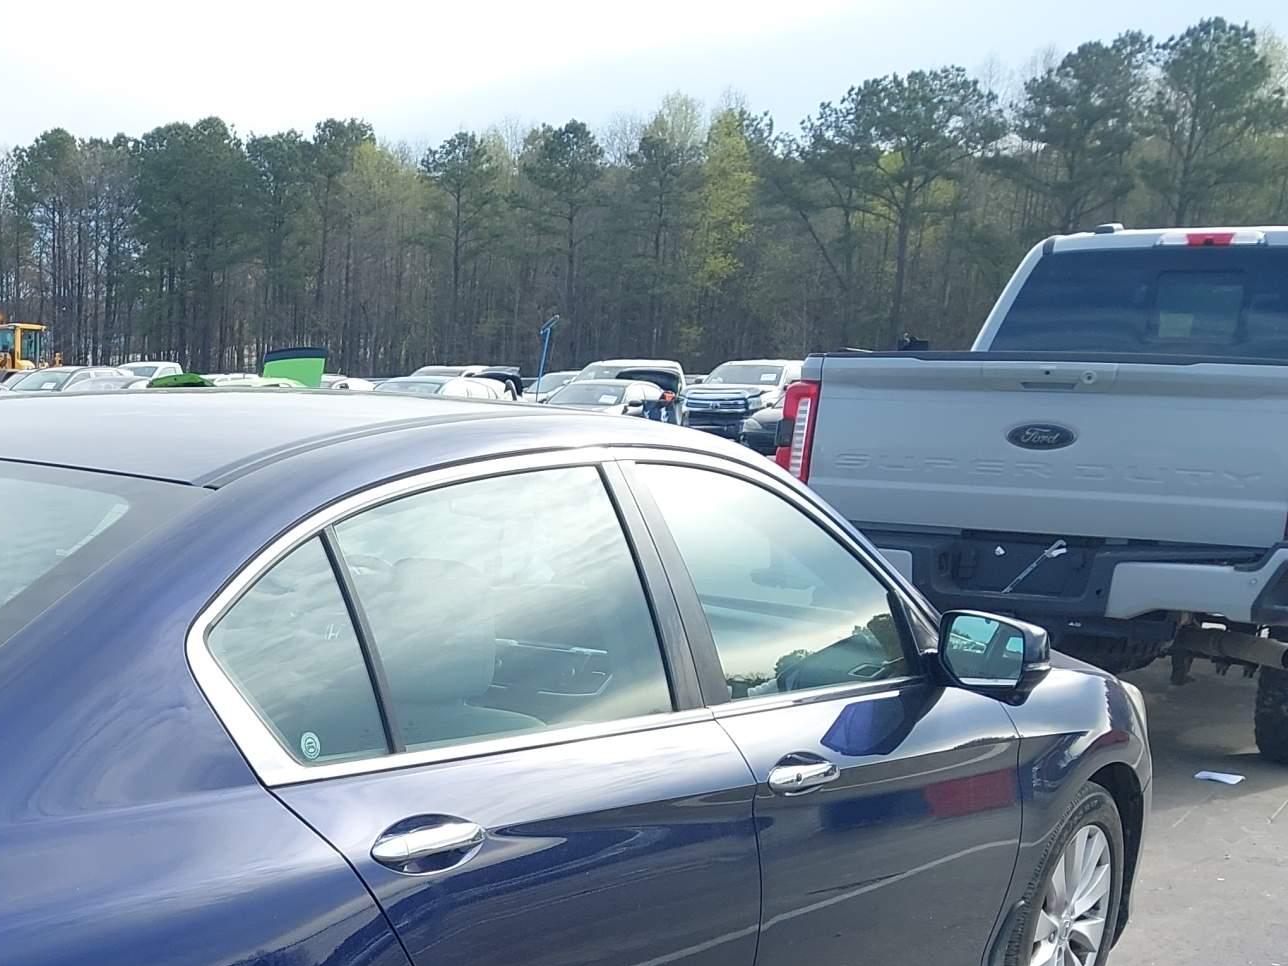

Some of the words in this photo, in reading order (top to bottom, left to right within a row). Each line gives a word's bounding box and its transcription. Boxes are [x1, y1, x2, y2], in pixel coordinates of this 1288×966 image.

[1020, 427, 1060, 444] Ford
[833, 453, 1053, 479] SUPER
[1073, 462, 1264, 489] DUTY
